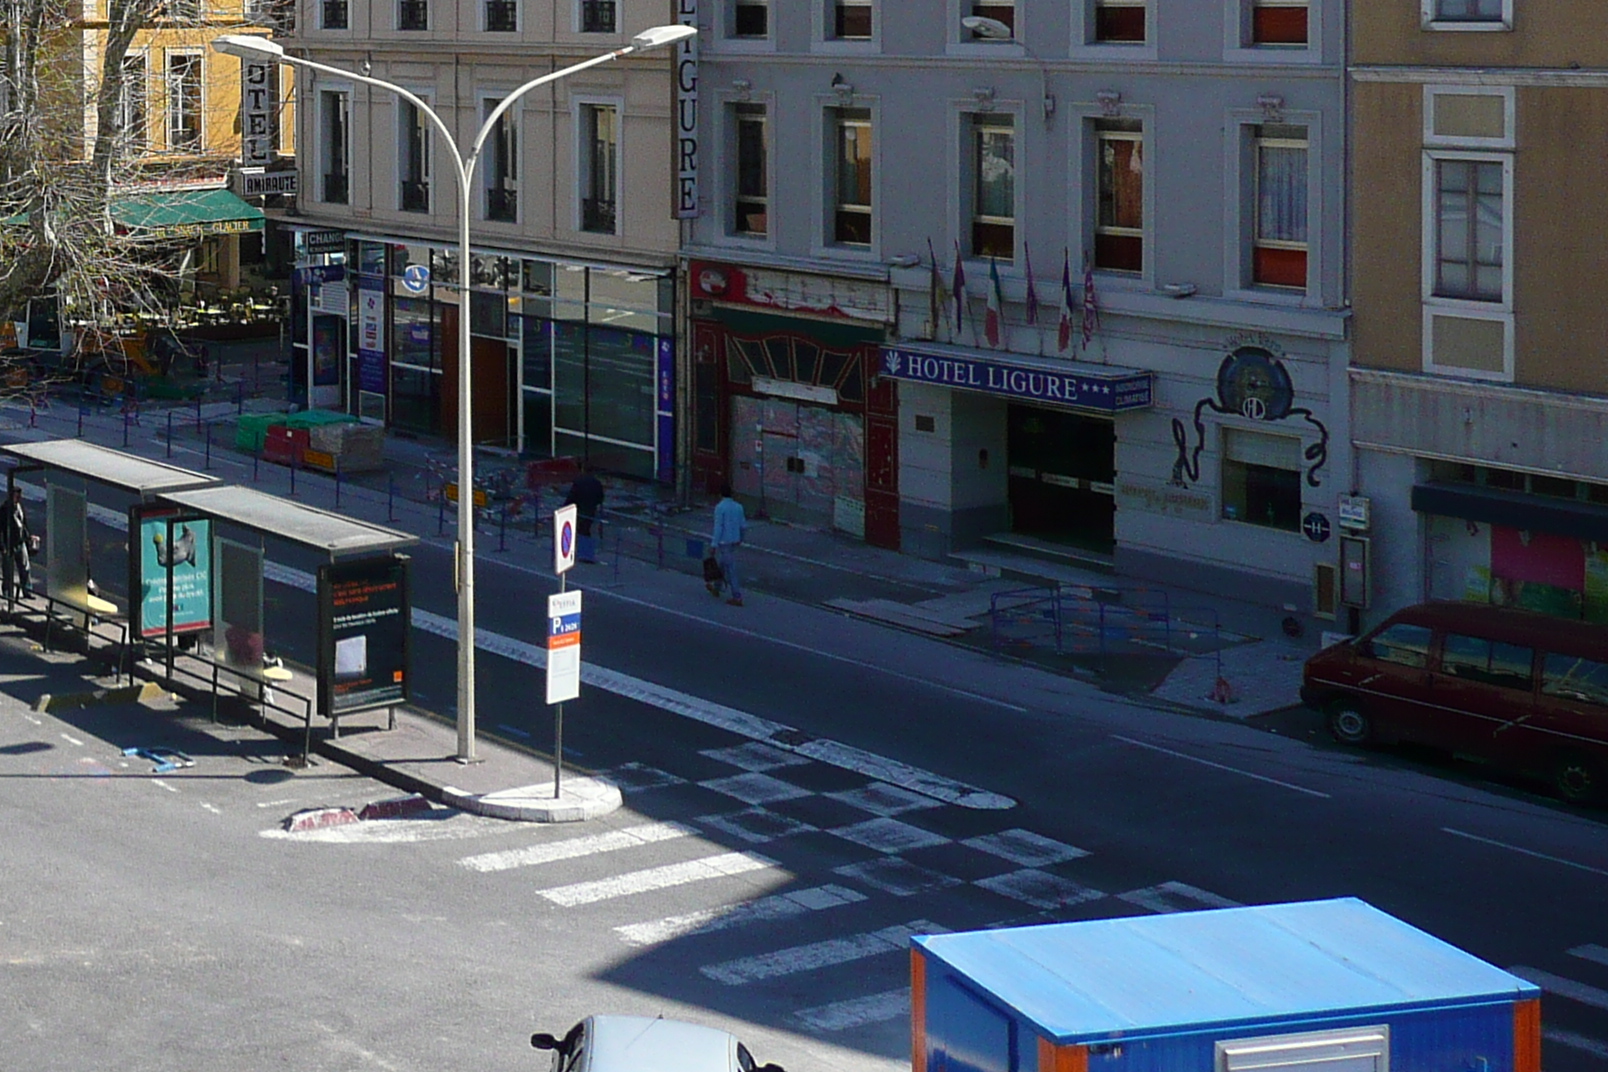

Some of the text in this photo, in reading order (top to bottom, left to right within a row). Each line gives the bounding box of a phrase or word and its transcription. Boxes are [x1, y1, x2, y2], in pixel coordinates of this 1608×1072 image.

[211, 221, 249, 234] GLACIER
[907, 355, 1079, 401] HOTEL LIGURE
